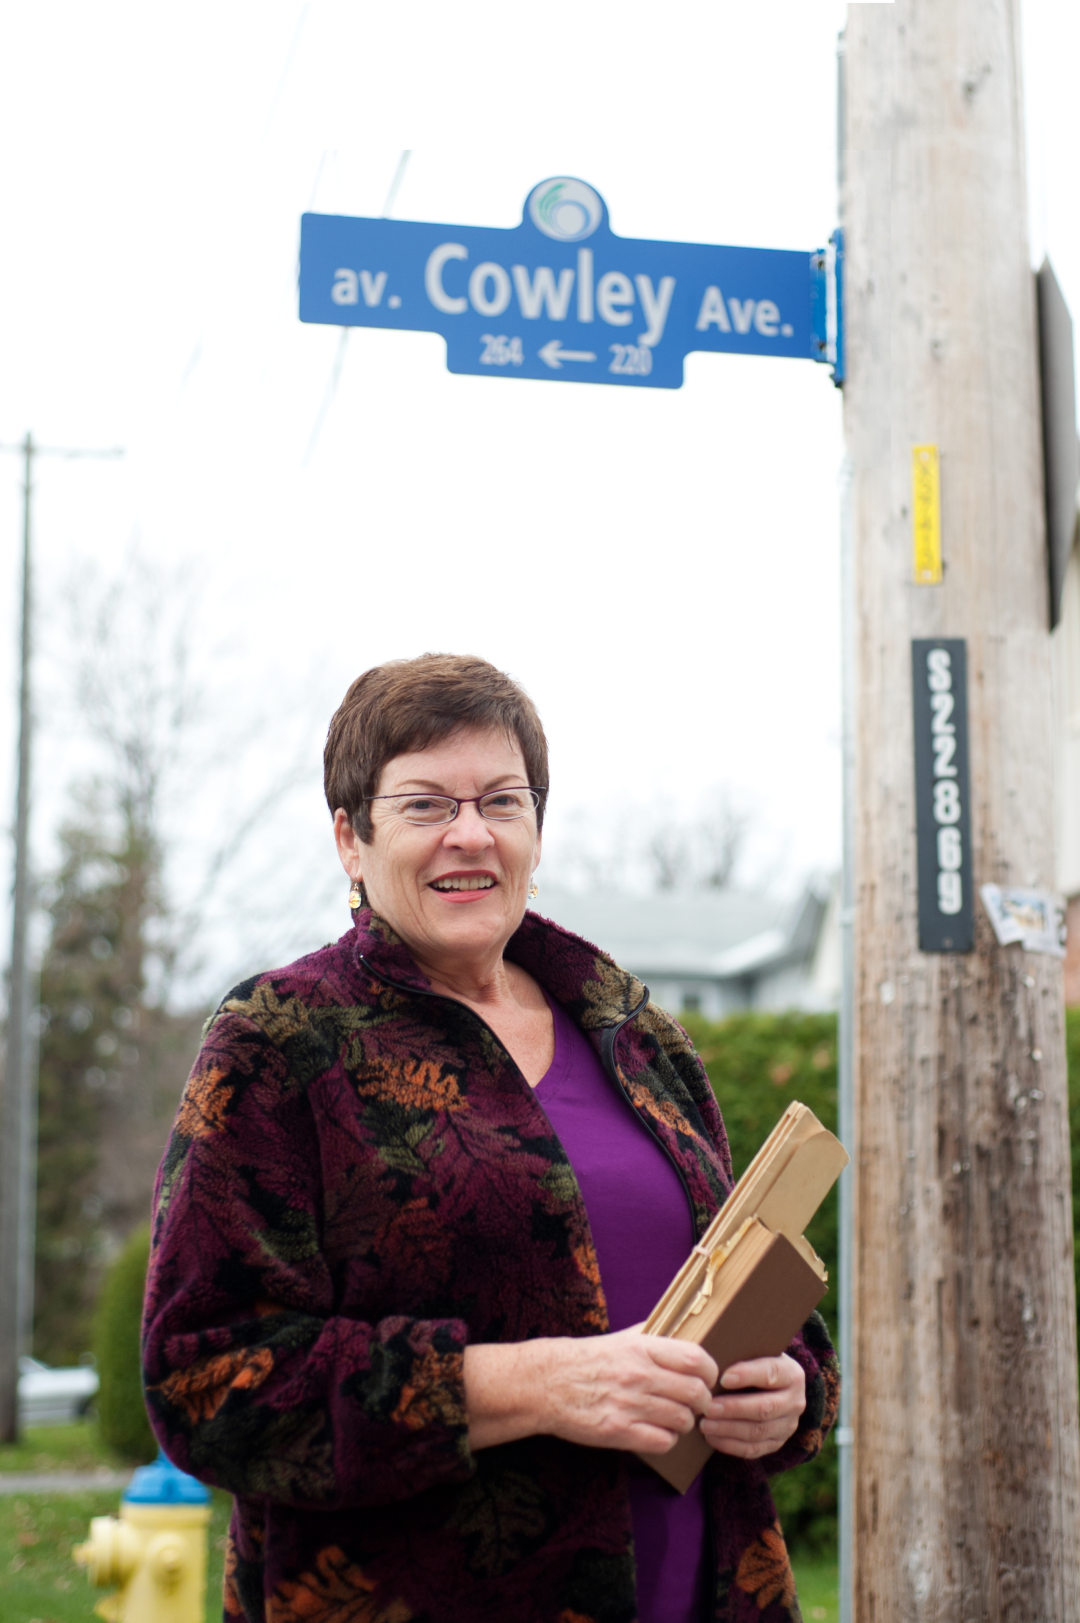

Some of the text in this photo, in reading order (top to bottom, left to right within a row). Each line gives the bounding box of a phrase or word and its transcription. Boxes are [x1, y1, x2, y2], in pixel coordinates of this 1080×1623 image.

[331, 242, 794, 347] av. Cowley Ave.
[479, 334, 654, 377] 264 220
[926, 648, 963, 915] S22869
